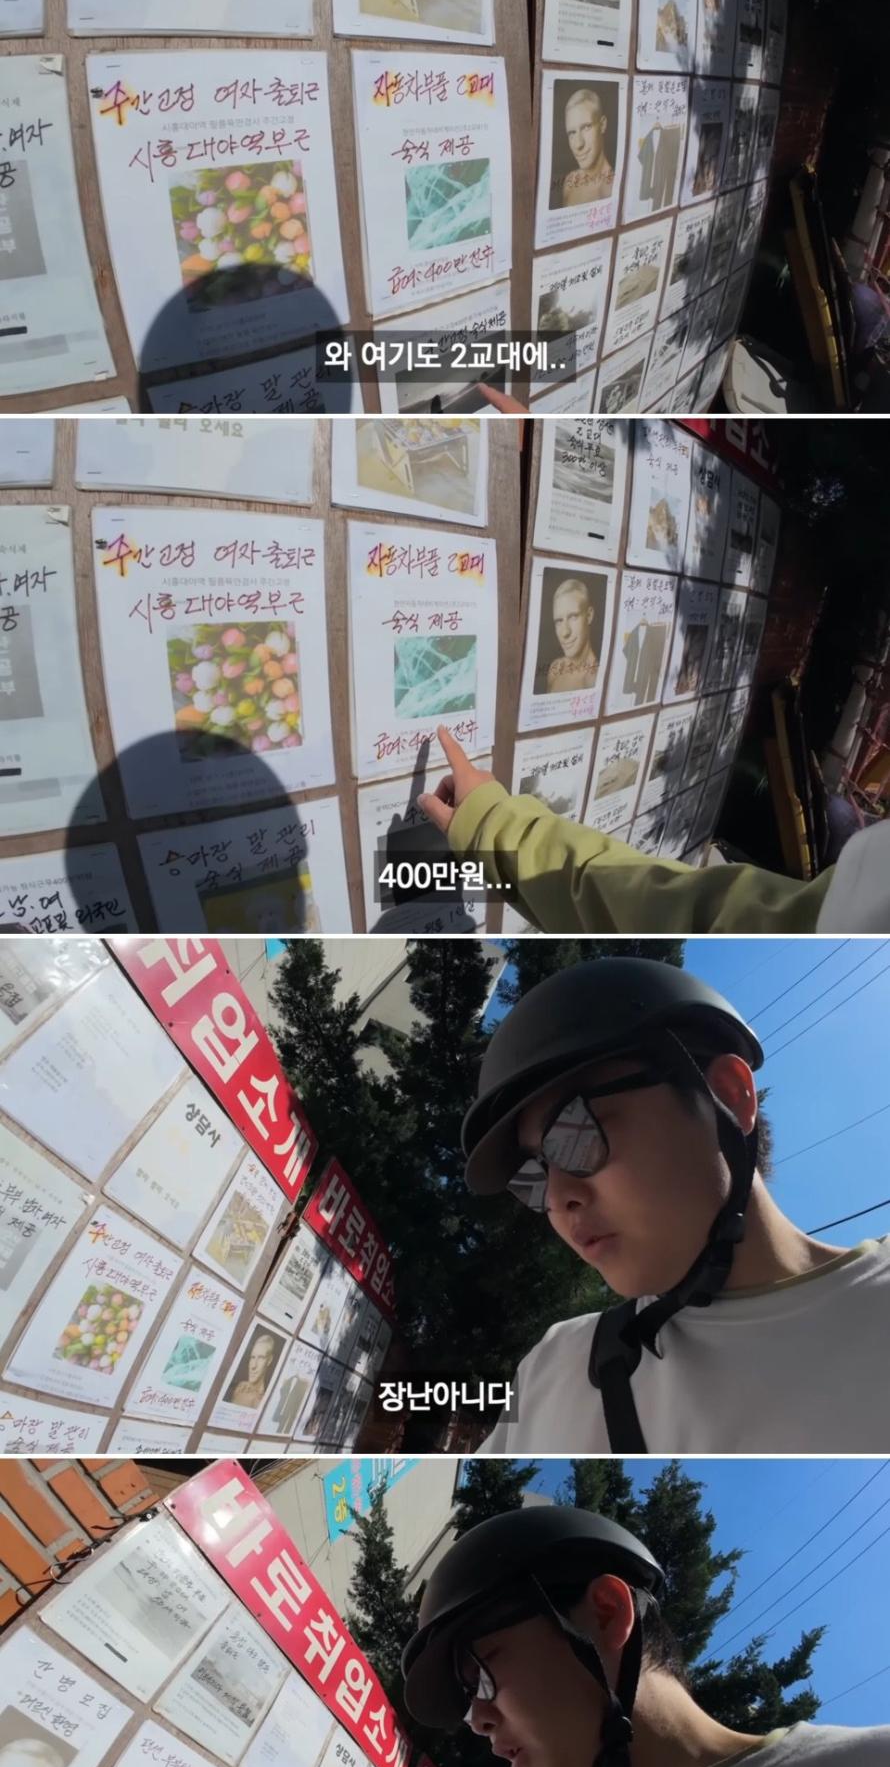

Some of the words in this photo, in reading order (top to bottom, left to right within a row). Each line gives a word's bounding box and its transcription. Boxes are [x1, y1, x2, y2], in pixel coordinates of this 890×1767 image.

[101, 80, 195, 125] 주간고정
[214, 78, 262, 109] 여자
[264, 77, 320, 108] 출퇴근
[374, 71, 449, 107] 자동차부품
[456, 72, 494, 97] 2교대
[129, 129, 311, 179] 시흥대야역부근
[391, 137, 430, 164] 숙식
[438, 134, 475, 158] 제공
[104, 534, 195, 576] 주간고정
[214, 540, 260, 568] 여자
[262, 539, 317, 569] 출퇴근
[368, 543, 441, 579] 자동차부품
[448, 549, 485, 574] 2교대
[129, 591, 304, 633] 시흥대야역부근
[382, 609, 420, 633] 숙식
[428, 610, 462, 631] 제공
[185, 1102, 222, 1148] 상담사
